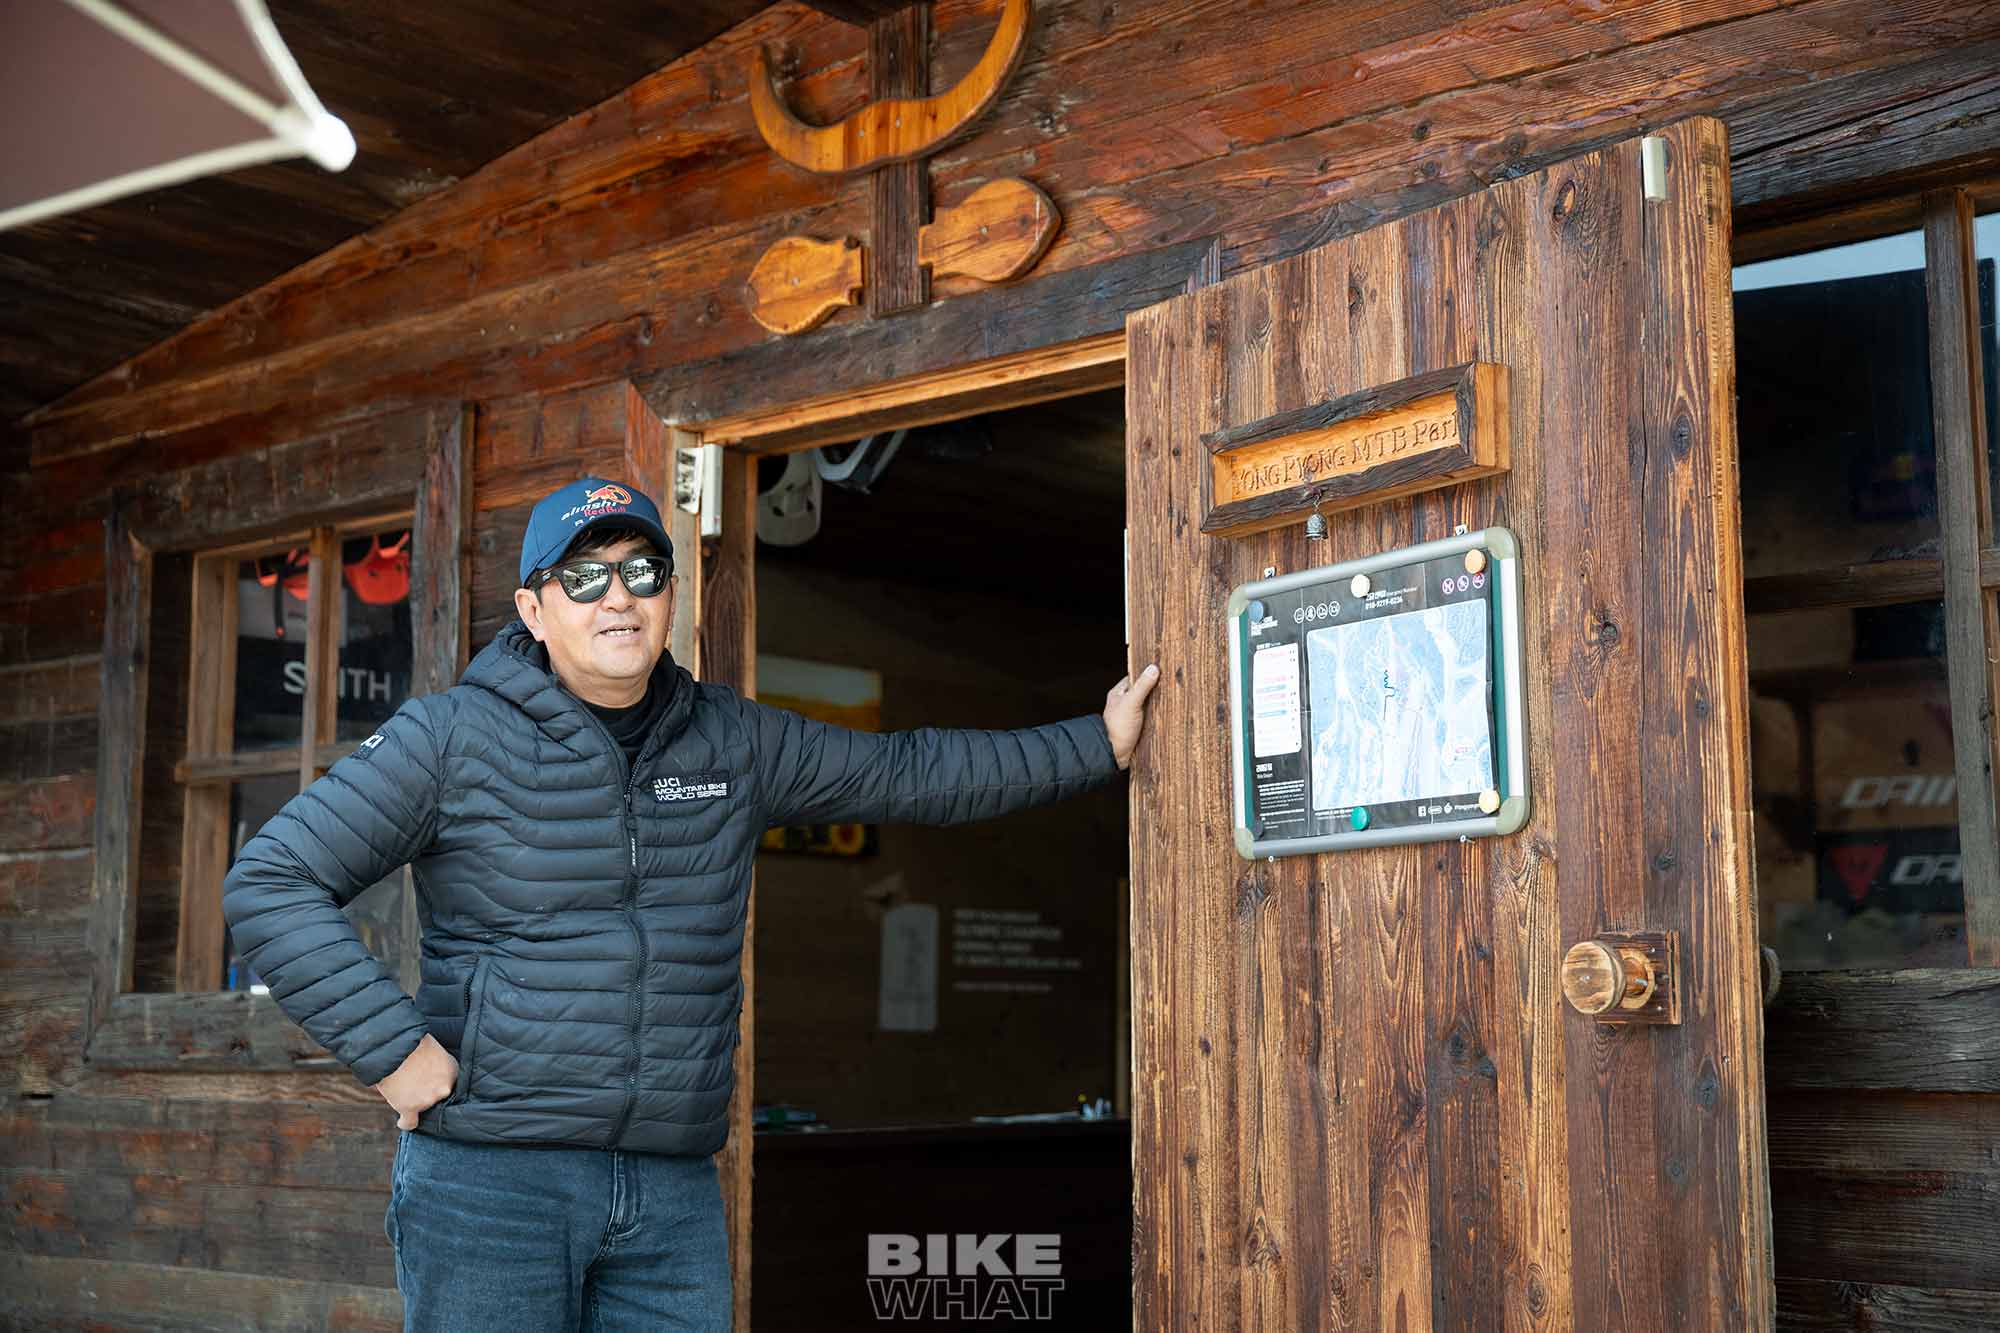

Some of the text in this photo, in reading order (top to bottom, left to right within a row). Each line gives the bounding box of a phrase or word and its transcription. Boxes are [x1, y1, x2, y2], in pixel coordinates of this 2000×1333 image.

[1351, 425, 1407, 465] MTB
[282, 660, 392, 703] SITH
[657, 777, 681, 788] UCI
[654, 784, 707, 795] MOUNTAIN
[656, 792, 695, 801] WORLD
